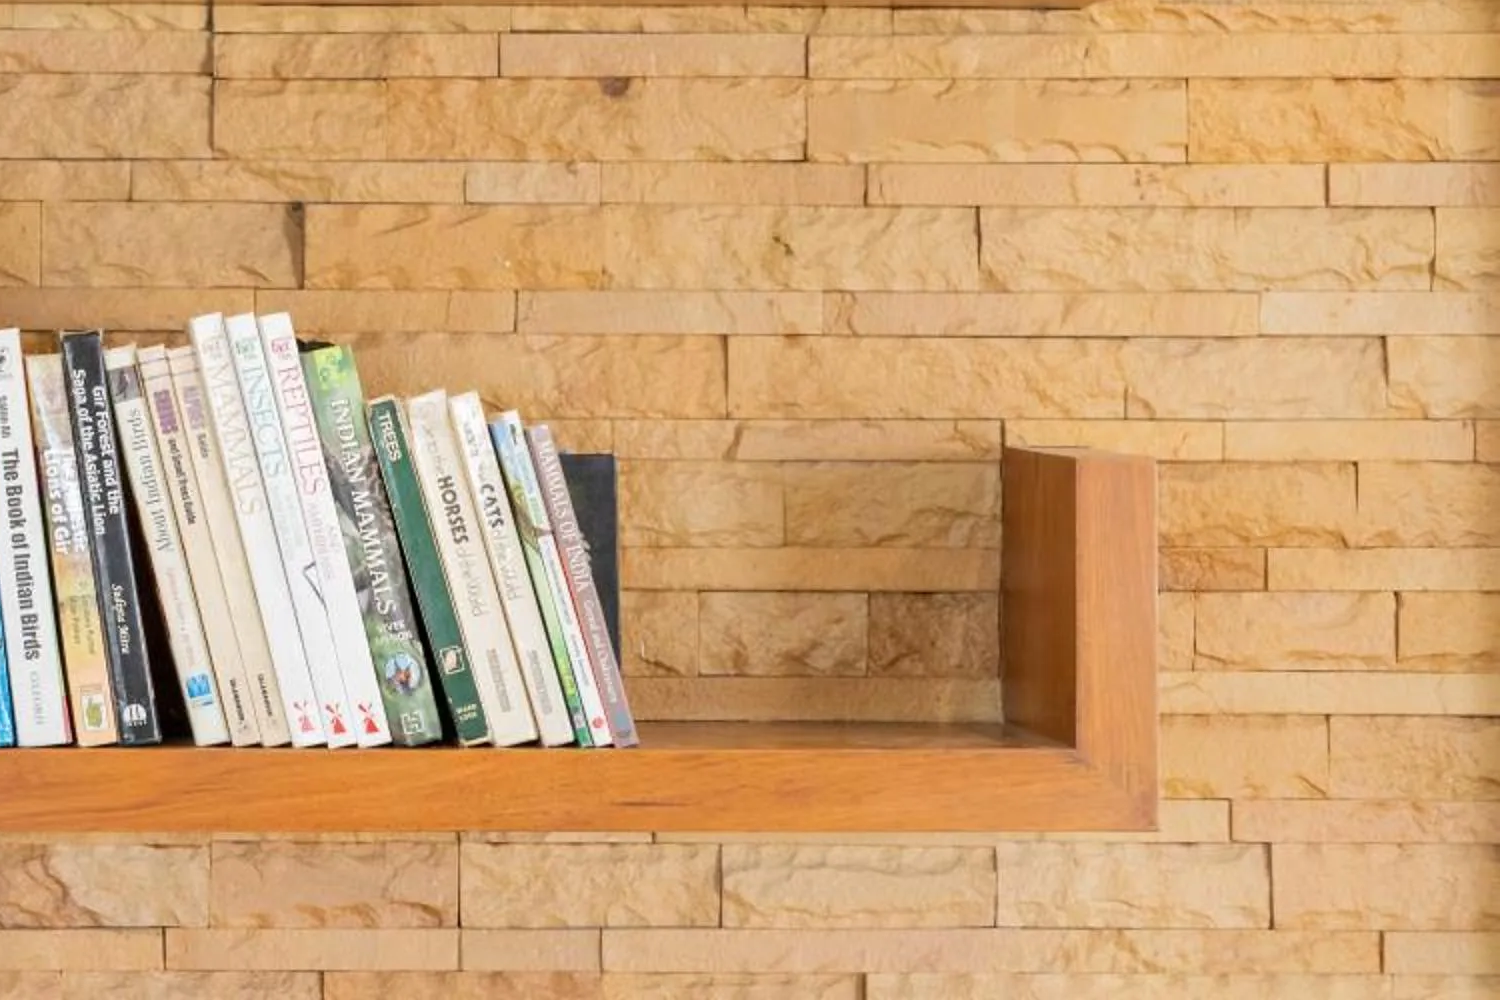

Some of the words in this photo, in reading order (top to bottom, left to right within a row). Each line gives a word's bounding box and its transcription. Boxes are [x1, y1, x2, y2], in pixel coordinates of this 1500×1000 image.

[70, 367, 90, 405] Saga
[91, 384, 107, 406] Gir
[77, 406, 92, 422] of
[94, 410, 115, 456] Forest
[124, 408, 147, 450] Birds
[240, 363, 290, 479] INSECTS
[276, 365, 326, 496] REPTILES
[375, 408, 404, 462] TREES
[79, 425, 95, 450] the
[206, 361, 263, 518] MAMMALS
[1, 449, 22, 481] The
[42, 449, 65, 500] Lions
[81, 451, 105, 502] Asiatic
[101, 458, 119, 487] and
[134, 451, 160, 505] Indian
[535, 440, 571, 520] MAMMALS
[4, 484, 27, 529] Book
[50, 502, 67, 522] of
[90, 504, 108, 536] Lion
[105, 488, 123, 514] the
[331, 397, 367, 483] INDIAN
[350, 486, 396, 616] MAMMALS
[437, 476, 467, 545] HORSES
[480, 482, 504, 529] CATS
[11, 532, 29, 550] of
[53, 525, 74, 556] Gir
[147, 508, 172, 555] About
[559, 520, 577, 541] OF
[12, 553, 37, 610] Indian
[564, 543, 591, 593] INDIA
[19, 613, 43, 661] Birds
